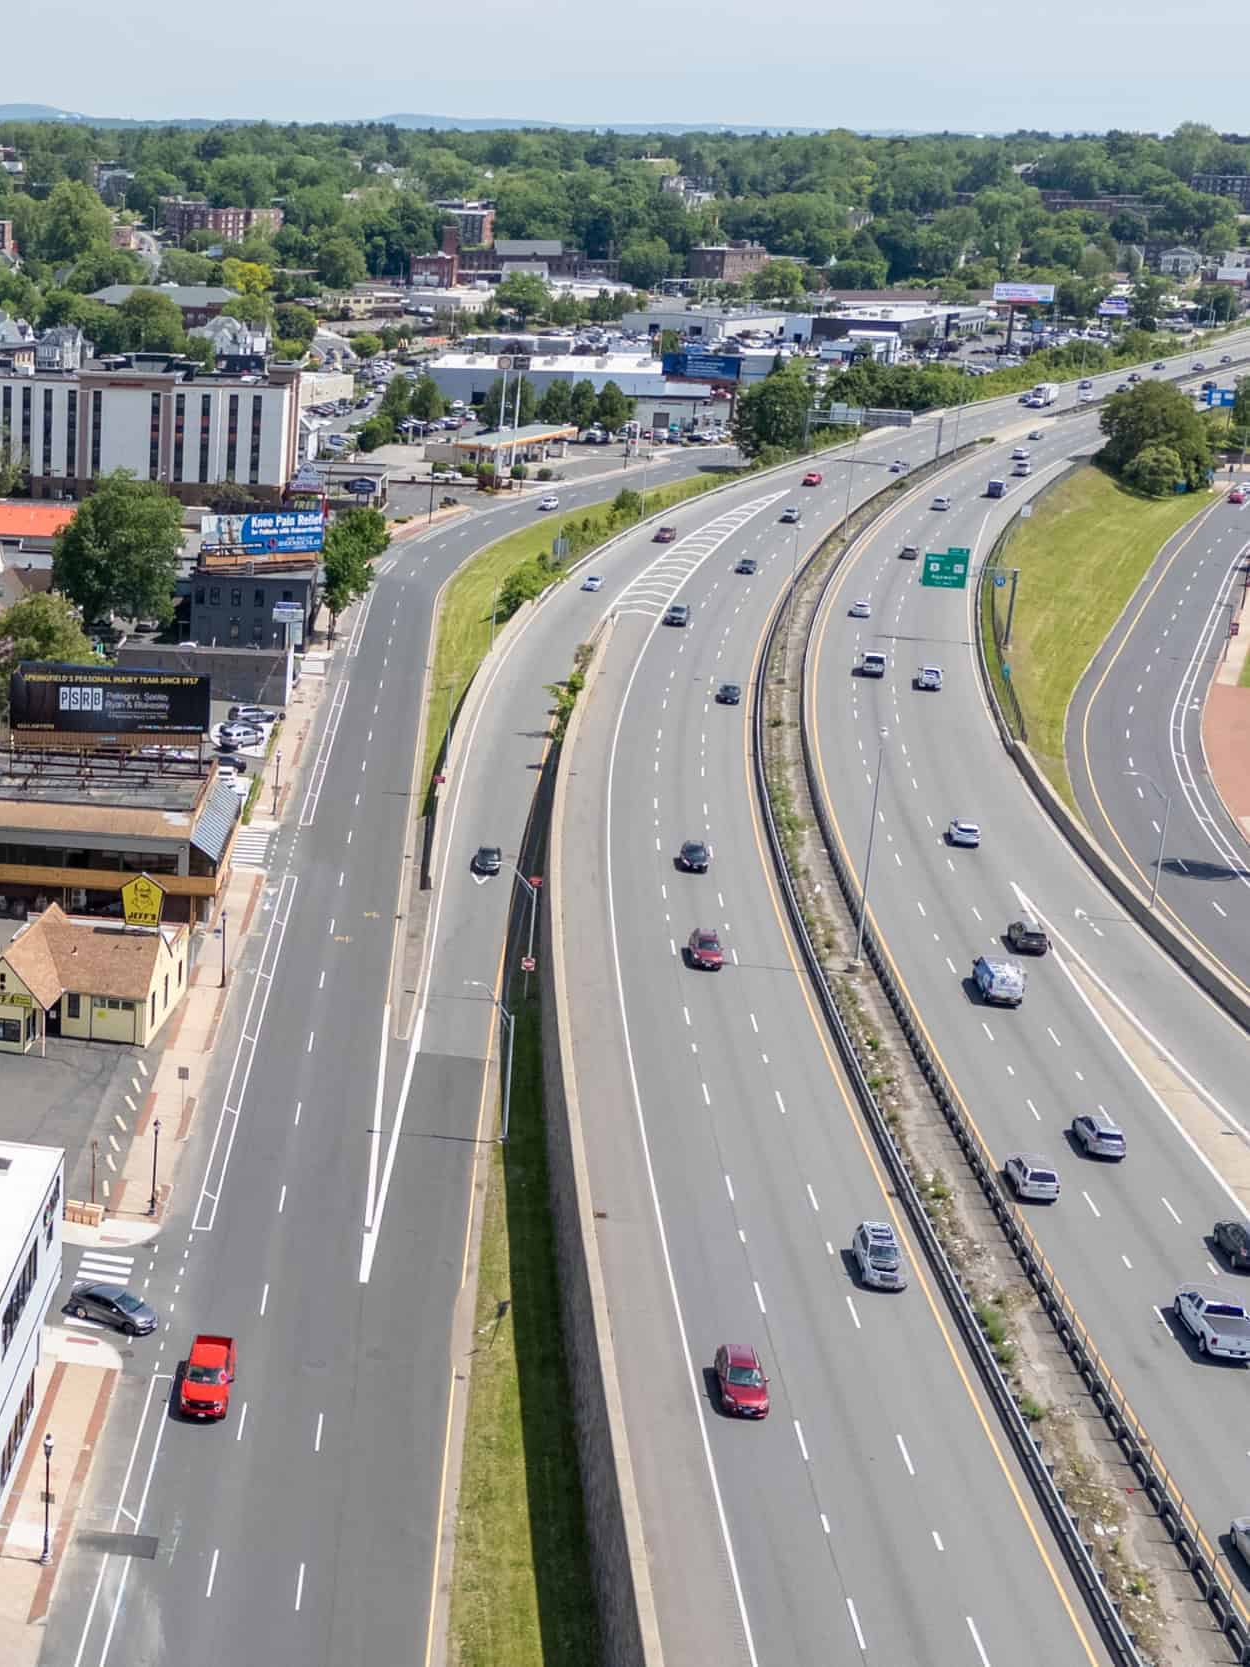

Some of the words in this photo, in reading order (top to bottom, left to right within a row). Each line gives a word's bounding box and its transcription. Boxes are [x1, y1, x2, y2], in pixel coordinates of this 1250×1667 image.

[251, 516, 273, 528] Knee
[276, 515, 295, 527] Pain
[298, 513, 323, 526] Relief
[128, 911, 156, 921] JEFF'S
